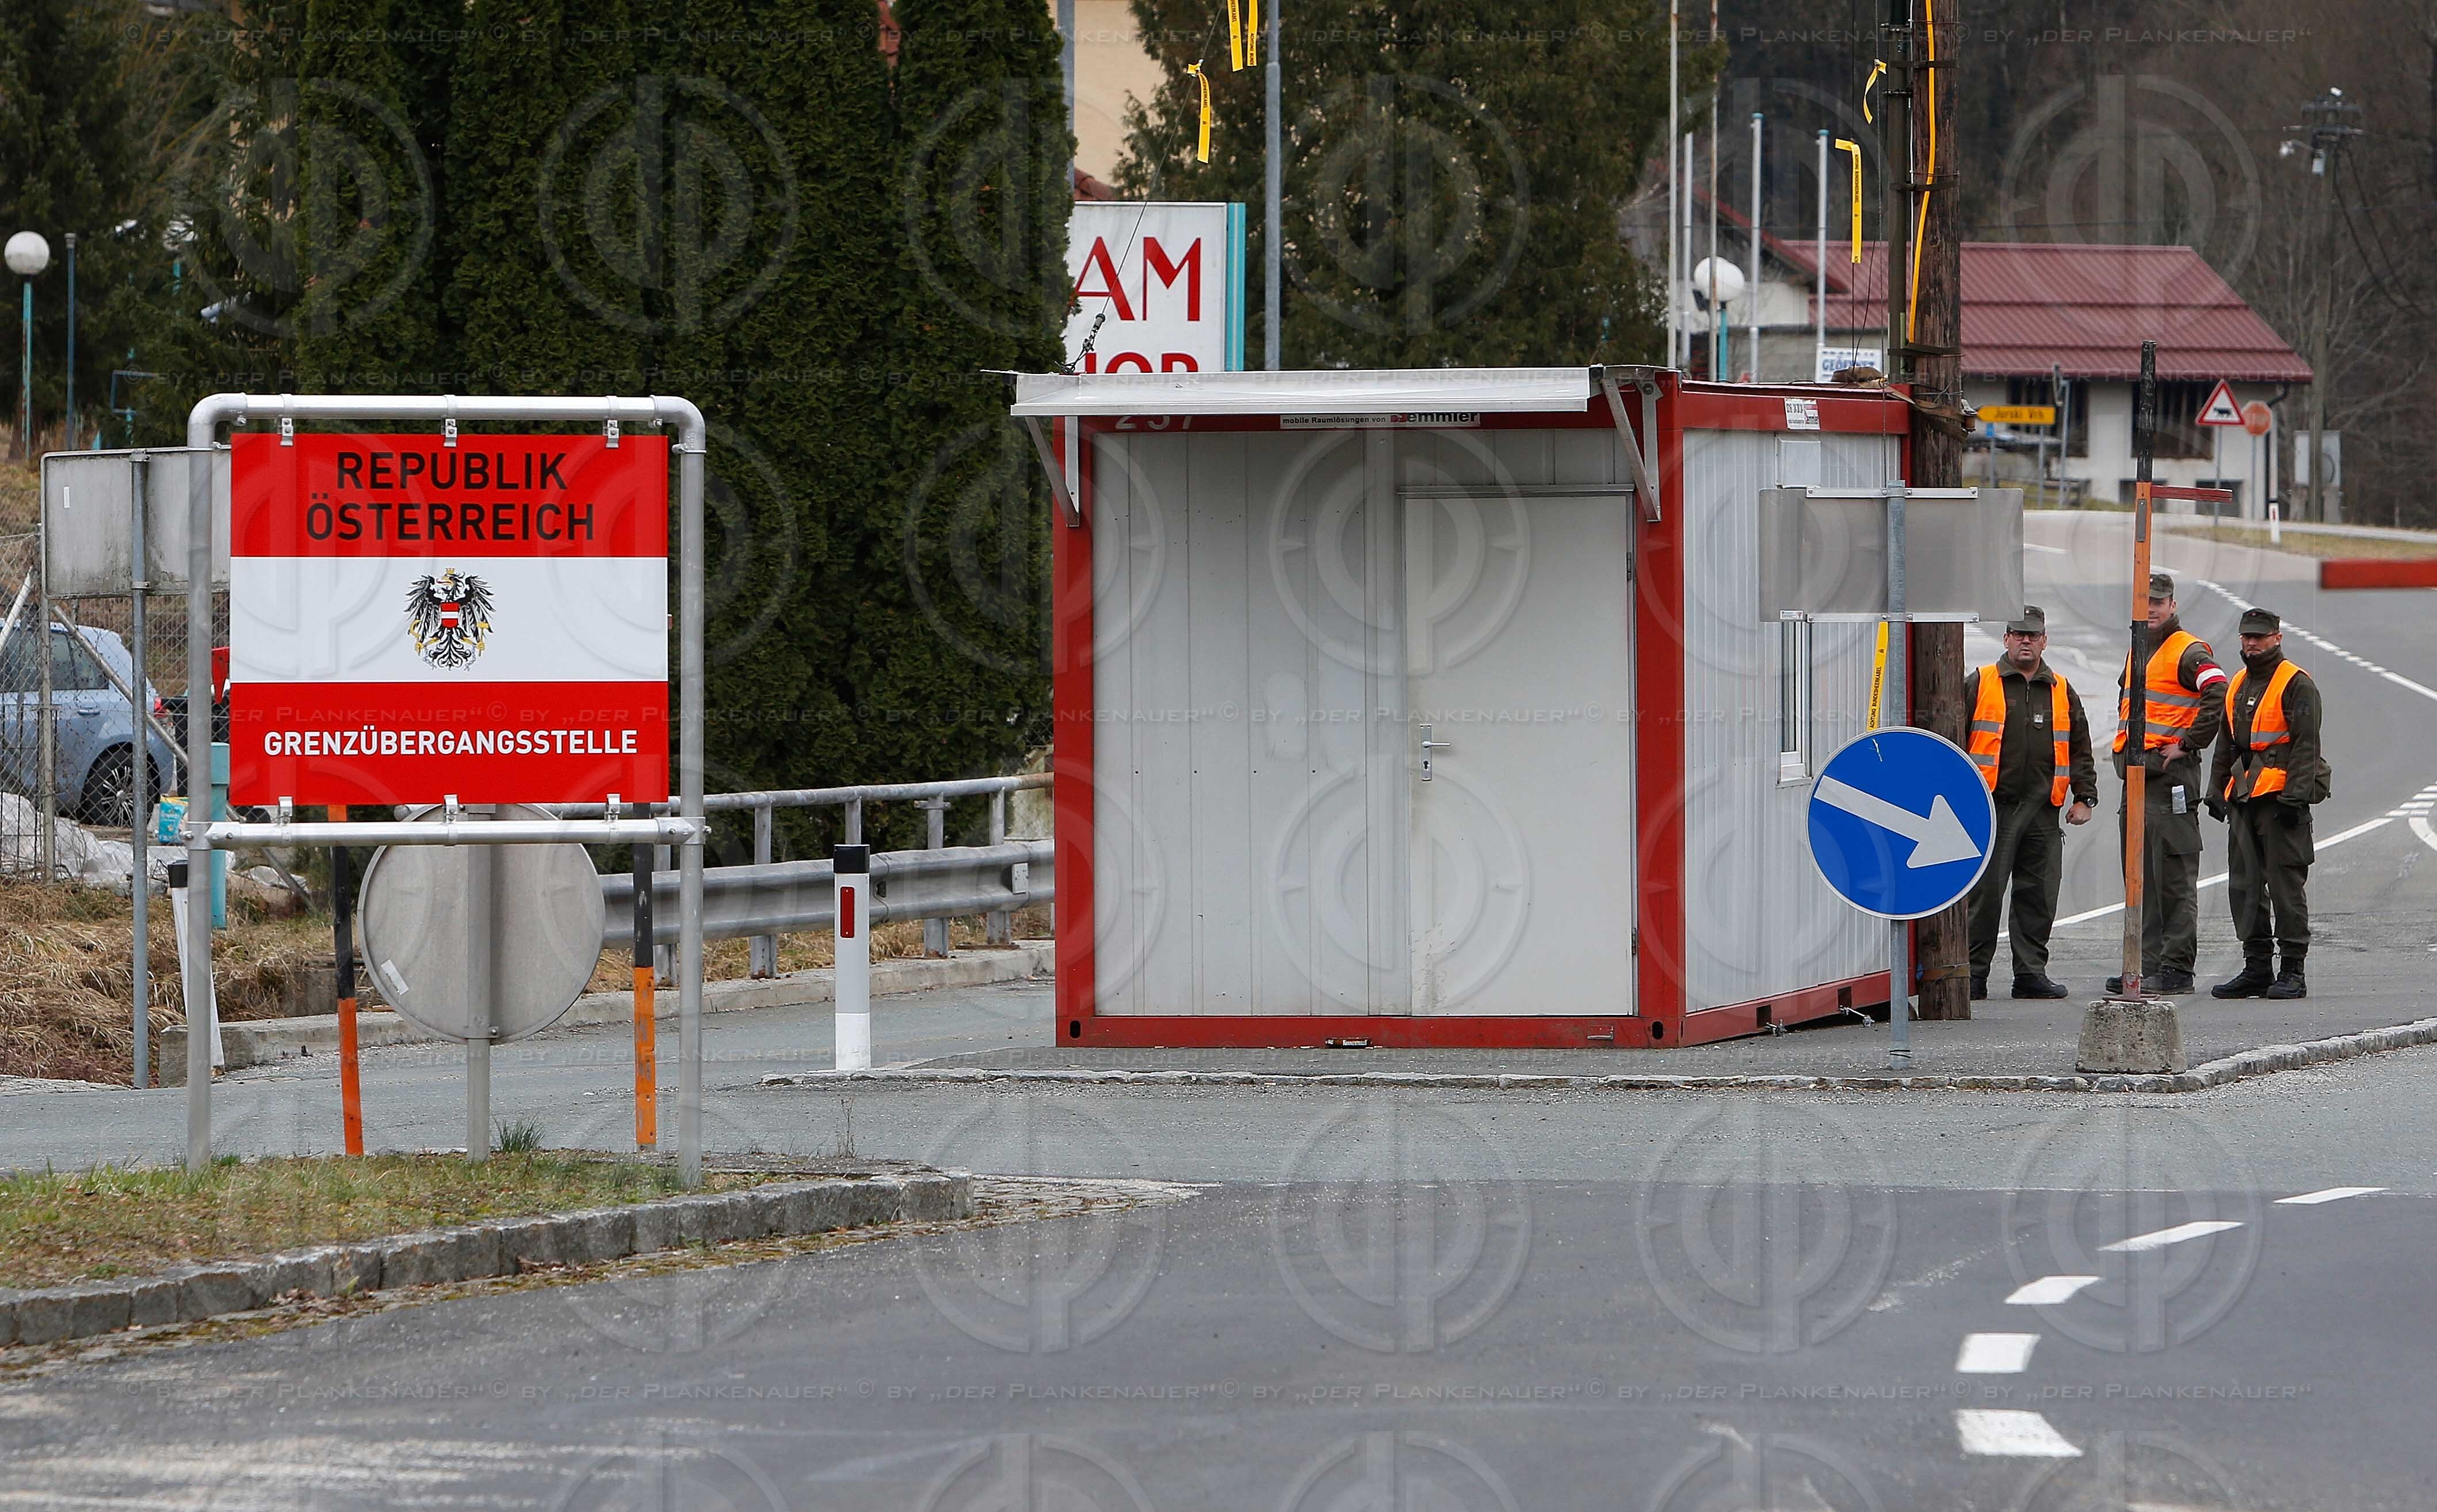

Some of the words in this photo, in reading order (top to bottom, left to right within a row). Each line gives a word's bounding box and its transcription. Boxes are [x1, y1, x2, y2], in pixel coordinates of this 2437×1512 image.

[1311, 416, 1369, 425] Raumlösungen
[337, 452, 567, 490] REPUBLIK
[307, 492, 594, 541] ÖSTERREICH
[263, 725, 637, 756] GRENZÜBERGANGSSTELLE
